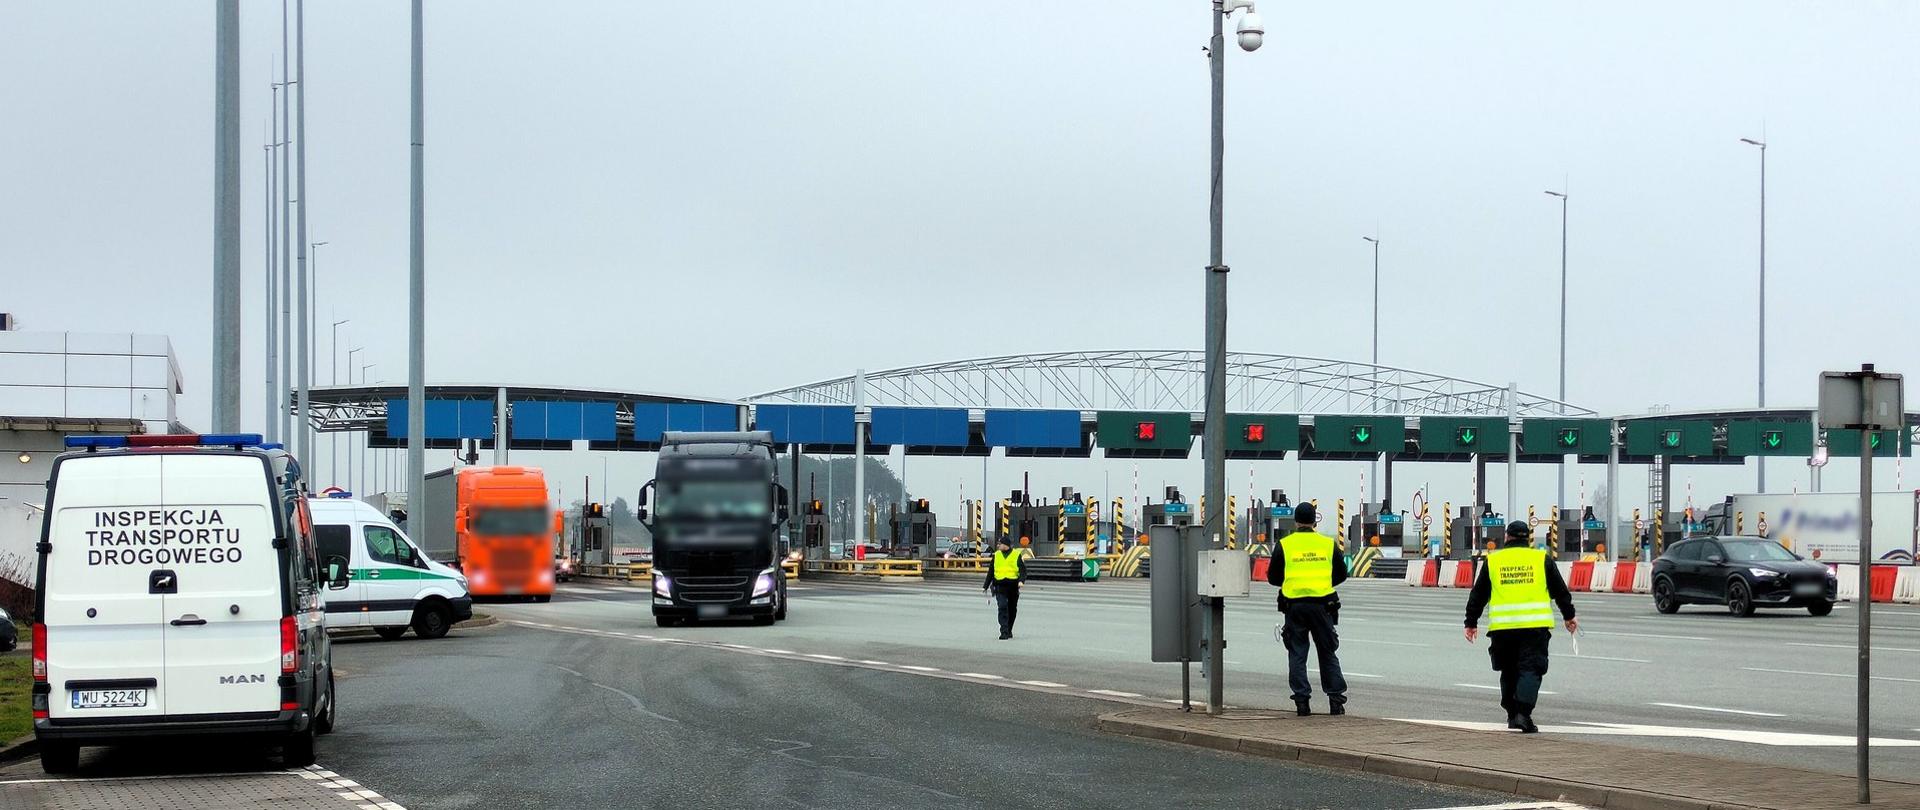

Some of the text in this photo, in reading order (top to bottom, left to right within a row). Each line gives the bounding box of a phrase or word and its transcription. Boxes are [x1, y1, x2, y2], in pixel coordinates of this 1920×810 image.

[95, 509, 223, 527] INSPEKCJA
[85, 528, 240, 546] TRANSPORTU
[88, 547, 242, 565] DROGOWEGO
[219, 674, 265, 684] MAN
[81, 690, 142, 704] WU 5224K
